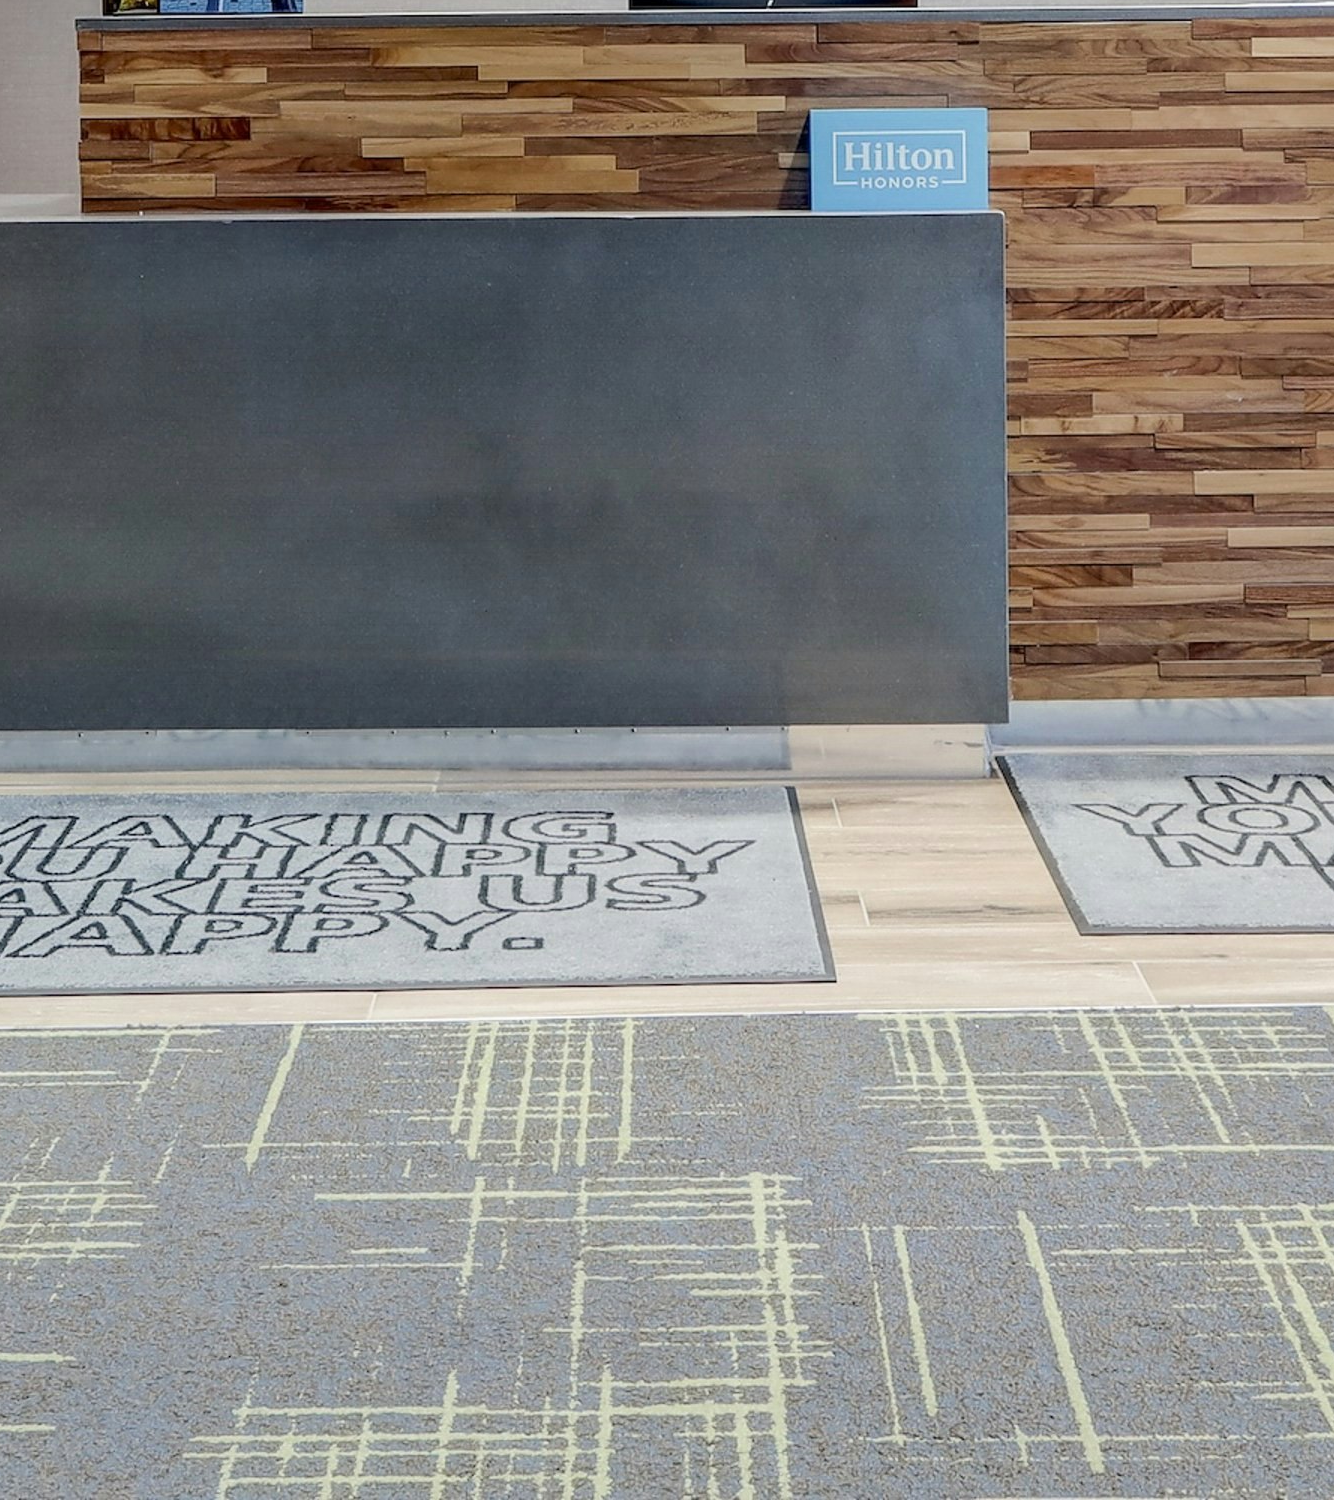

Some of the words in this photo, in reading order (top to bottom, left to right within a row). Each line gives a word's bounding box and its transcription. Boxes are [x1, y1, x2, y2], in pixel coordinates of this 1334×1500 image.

[844, 141, 955, 172] Hilton
[861, 176, 939, 189] HONORS
[175, 839, 757, 880] HAPPY
[478, 872, 708, 912] US
